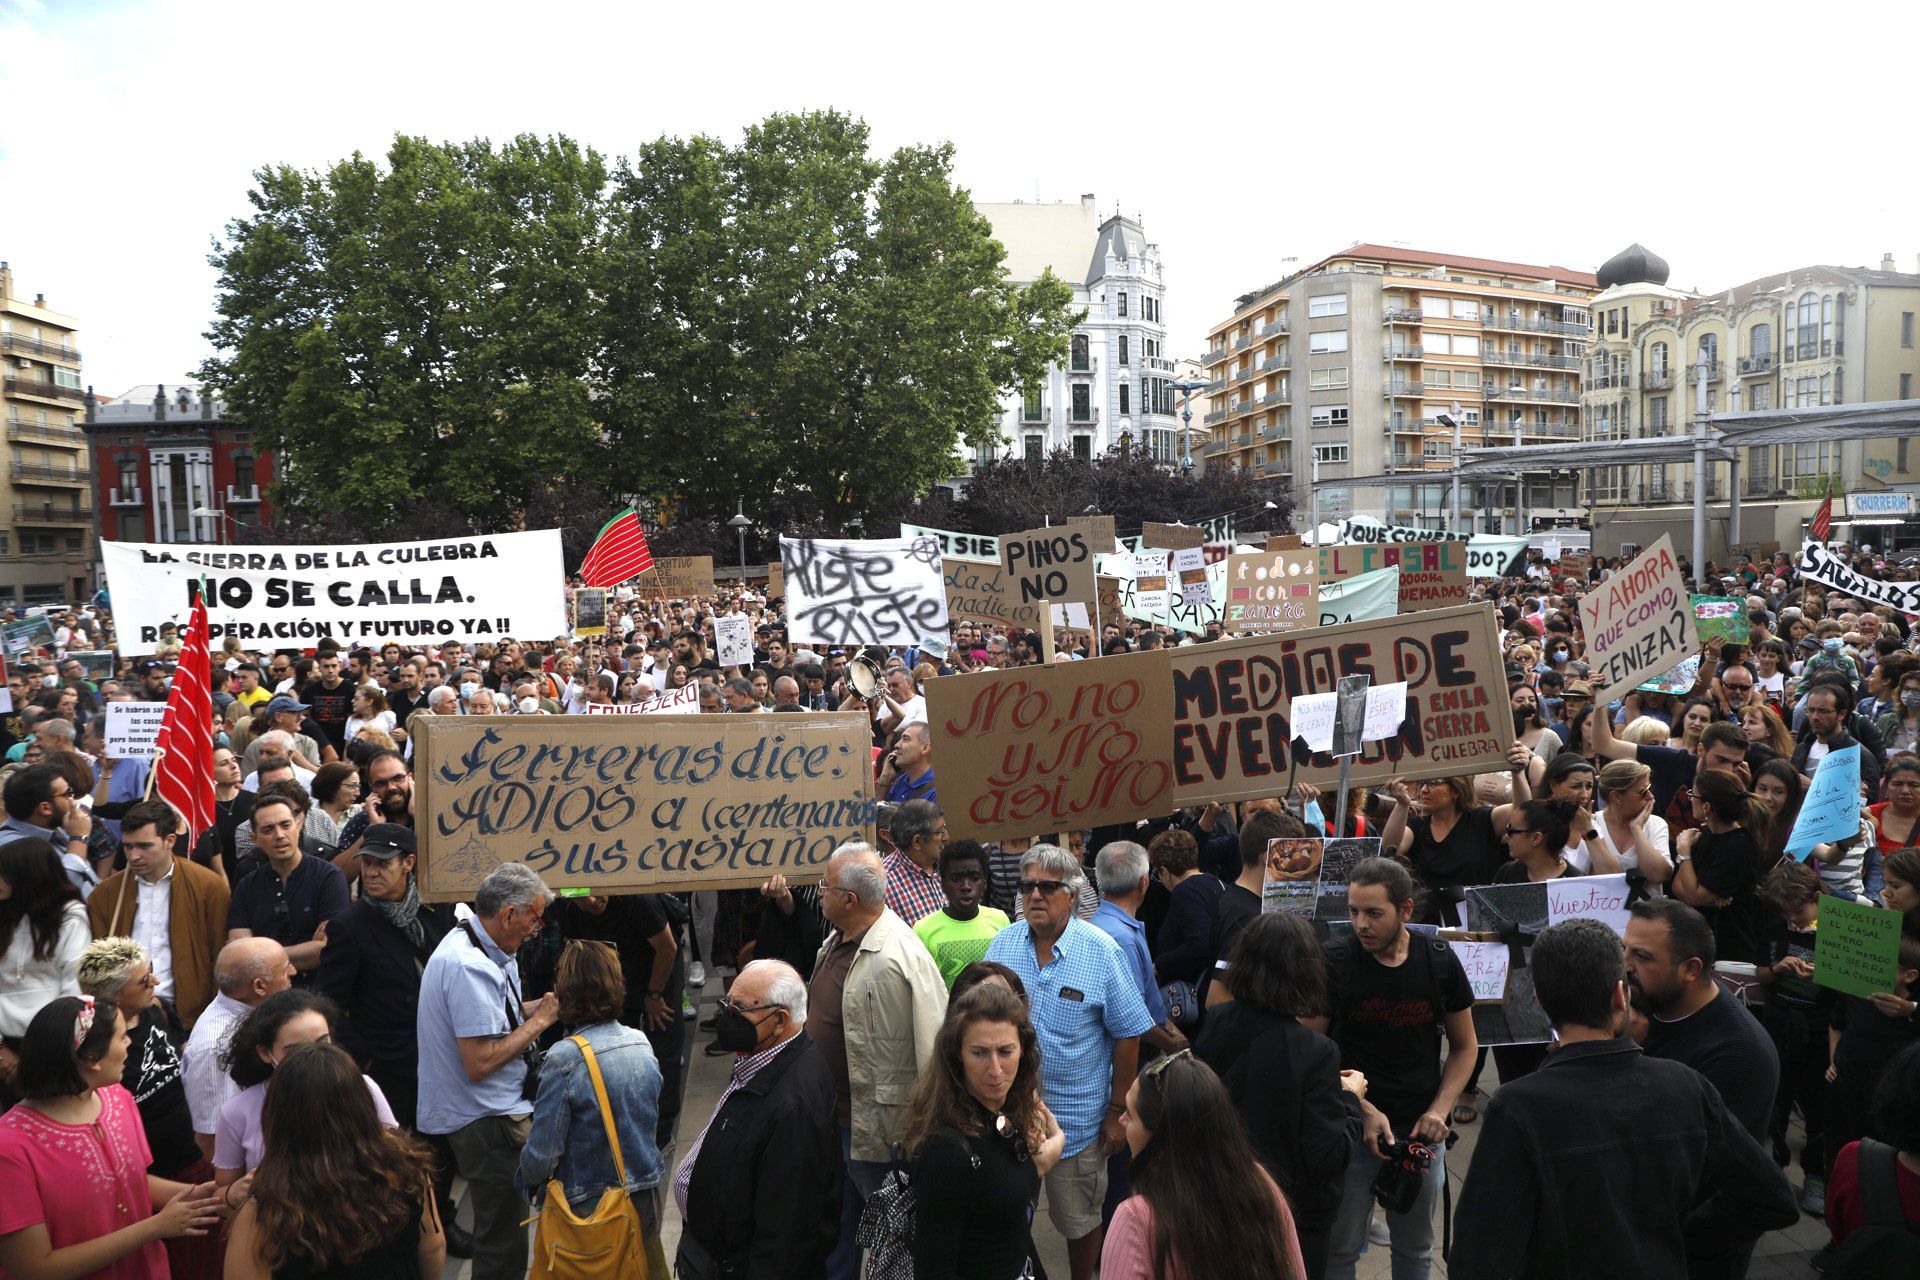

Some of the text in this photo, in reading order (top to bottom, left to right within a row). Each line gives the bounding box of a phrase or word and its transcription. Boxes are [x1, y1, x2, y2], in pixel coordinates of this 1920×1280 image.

[1855, 495, 1908, 511] CHURRERIA
[140, 541, 498, 571] LA SIERRA DE LA CULEBRA
[1237, 556, 1315, 581] todos
[1363, 543, 1459, 574] CASAL
[187, 576, 476, 609] NO SE CALLA.
[1020, 571, 1068, 604] NO
[1255, 585, 1288, 601] con
[1400, 584, 1466, 602] UEMADAS
[1586, 597, 1600, 629] Y
[1608, 548, 1674, 620] AHORA
[338, 621, 354, 638] Y
[360, 619, 454, 637] FUTURO
[1594, 618, 1624, 653] QUE
[1393, 630, 1476, 690] DE
[1068, 678, 1141, 721] no
[1423, 710, 1491, 742] SIERRA
[730, 735, 851, 781] dice:
[1431, 738, 1501, 762] CULEBRA
[514, 838, 629, 874] sus
[1829, 919, 1882, 940] EL CASAL
[1464, 943, 1486, 959] TE
